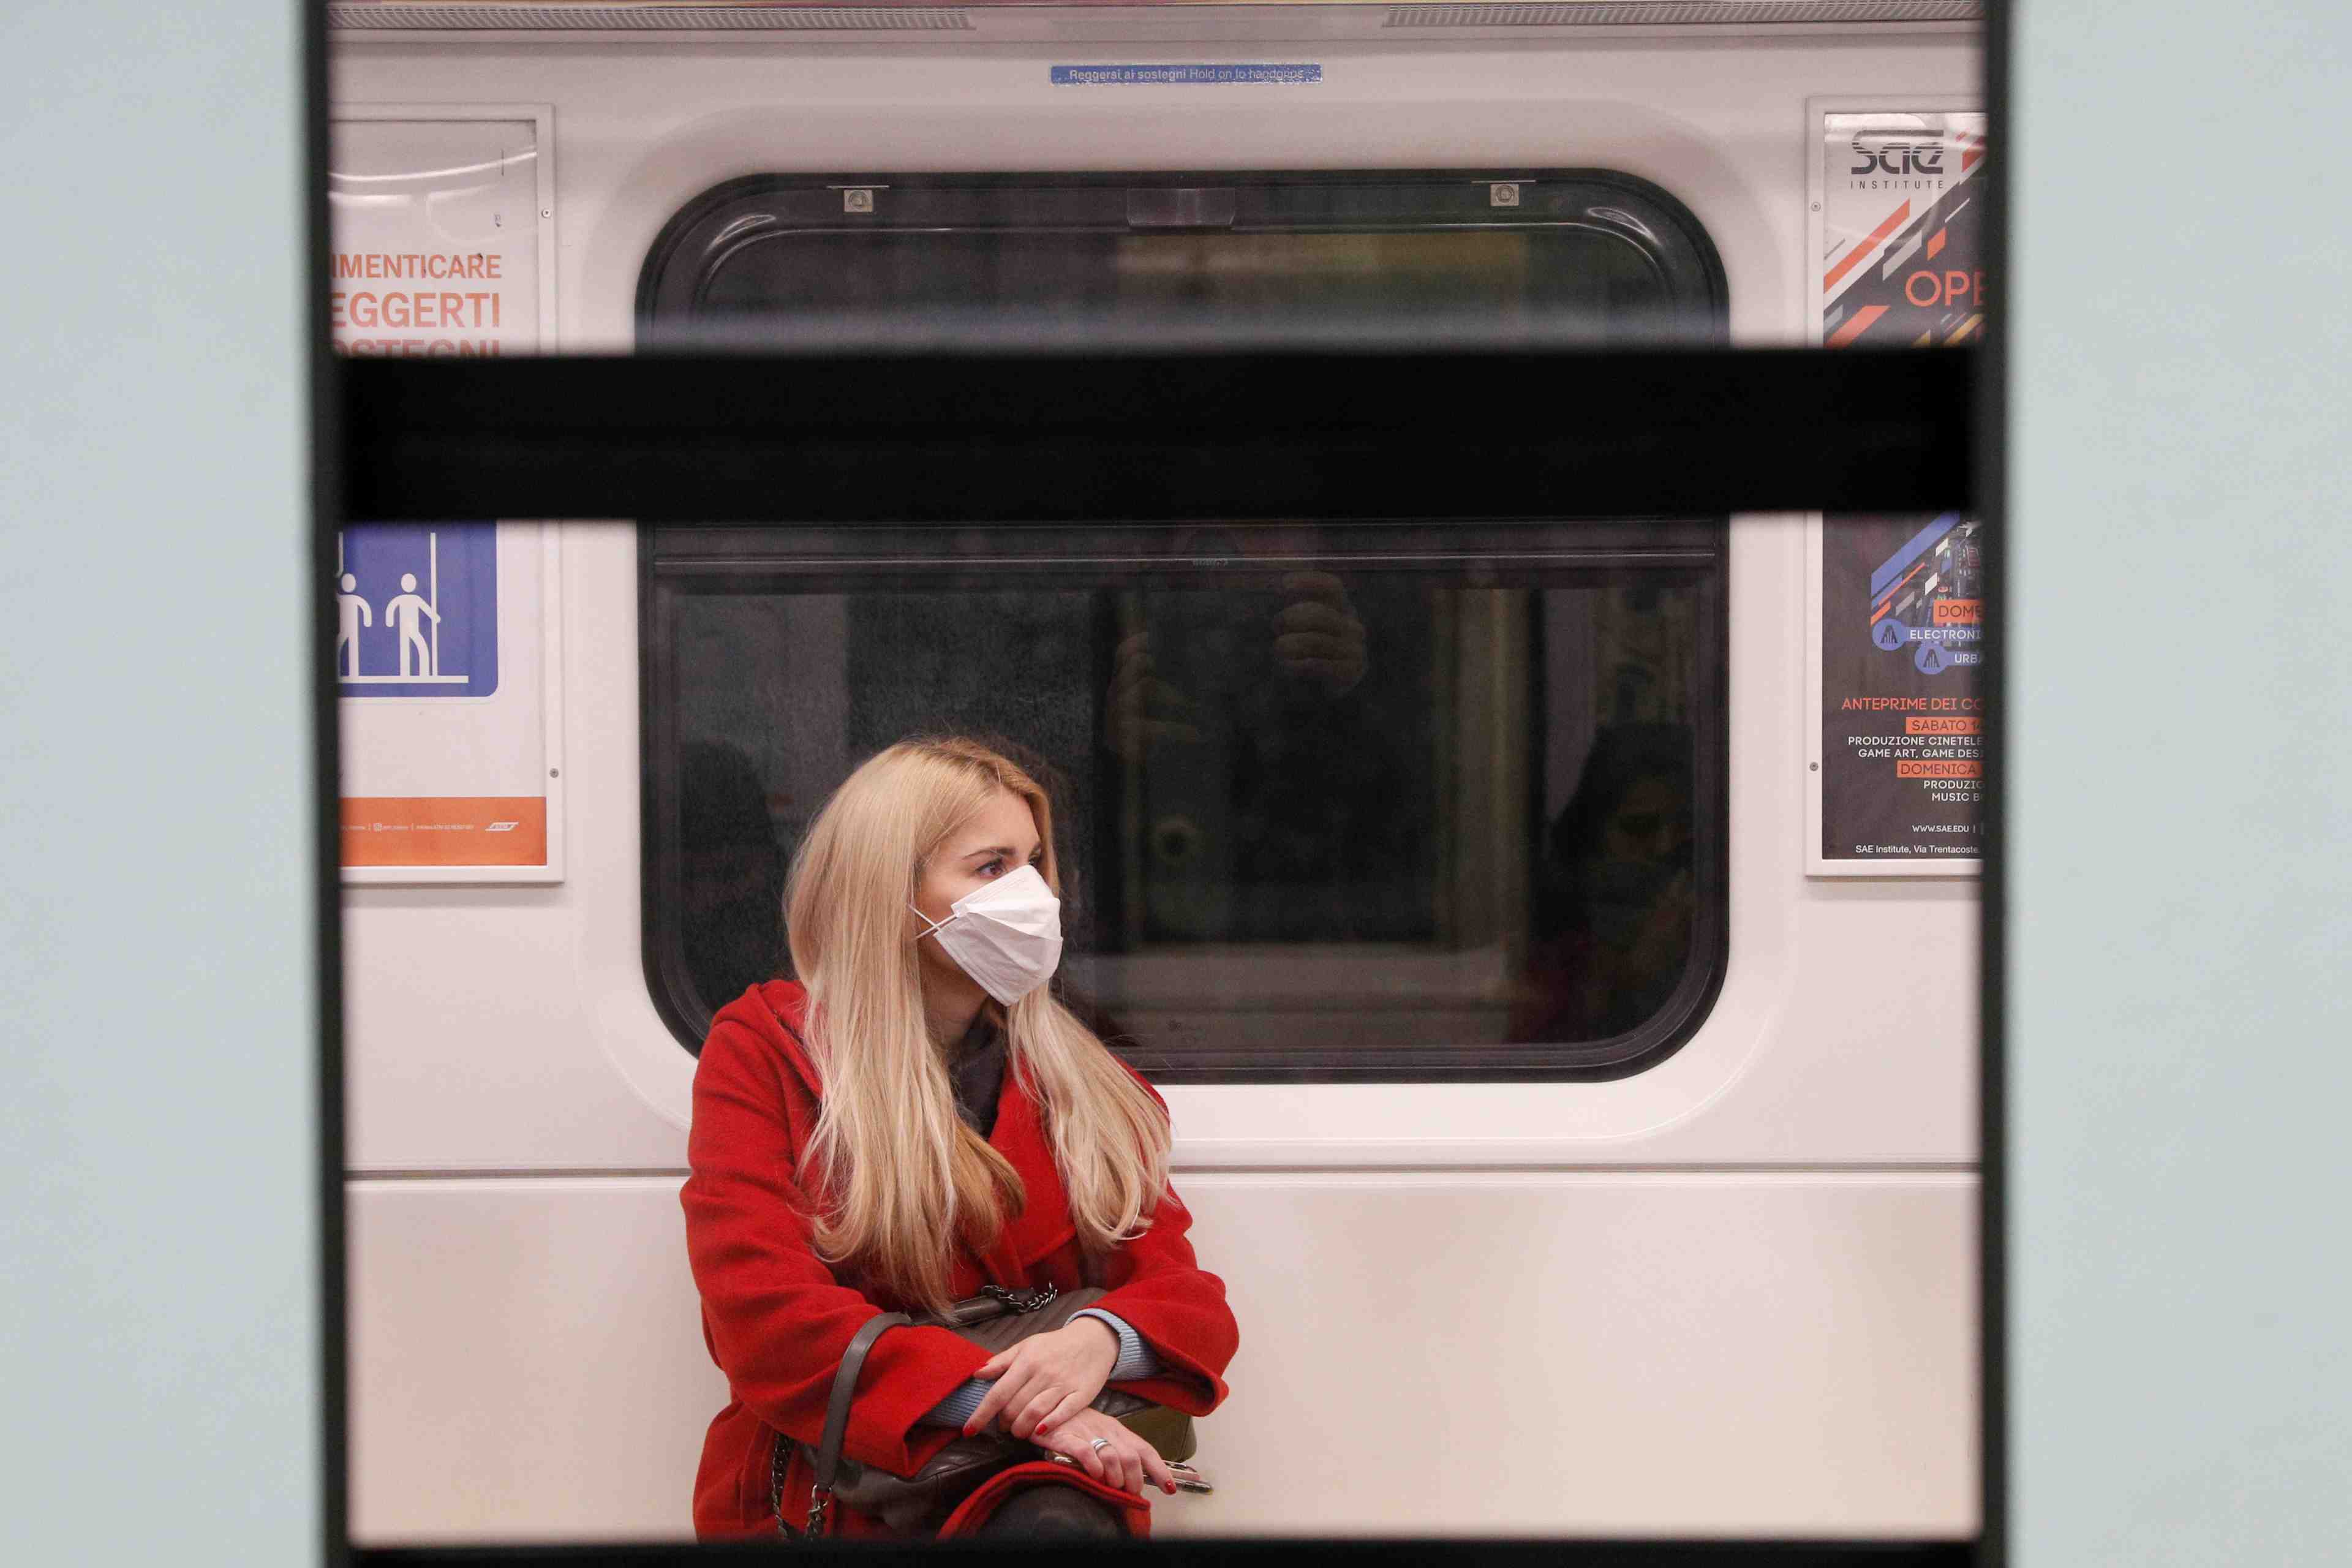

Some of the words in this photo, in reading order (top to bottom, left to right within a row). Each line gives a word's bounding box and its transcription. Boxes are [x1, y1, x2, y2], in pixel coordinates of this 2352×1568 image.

[1124, 69, 1134, 79] ai
[1137, 69, 1186, 81] sostegni
[1189, 69, 1215, 79] Hold
[1218, 70, 1232, 79] on
[1850, 181, 1944, 190] INSTITUTE
[1954, 654, 1981, 663] URB
[1842, 698, 1926, 710] ANTEPRIME
[1931, 698, 1956, 710] DEI
[1912, 720, 1967, 731] SABATO
[1848, 737, 1924, 745] PRODUZIONE
[1858, 749, 1891, 758] GAME
[1894, 749, 1918, 759] ART,
[1922, 749, 1954, 758] GAME
[1901, 764, 1976, 775] DOMENICA
[1932, 793, 1969, 801] MUSIC
[1876, 845, 1911, 854] Institute,
